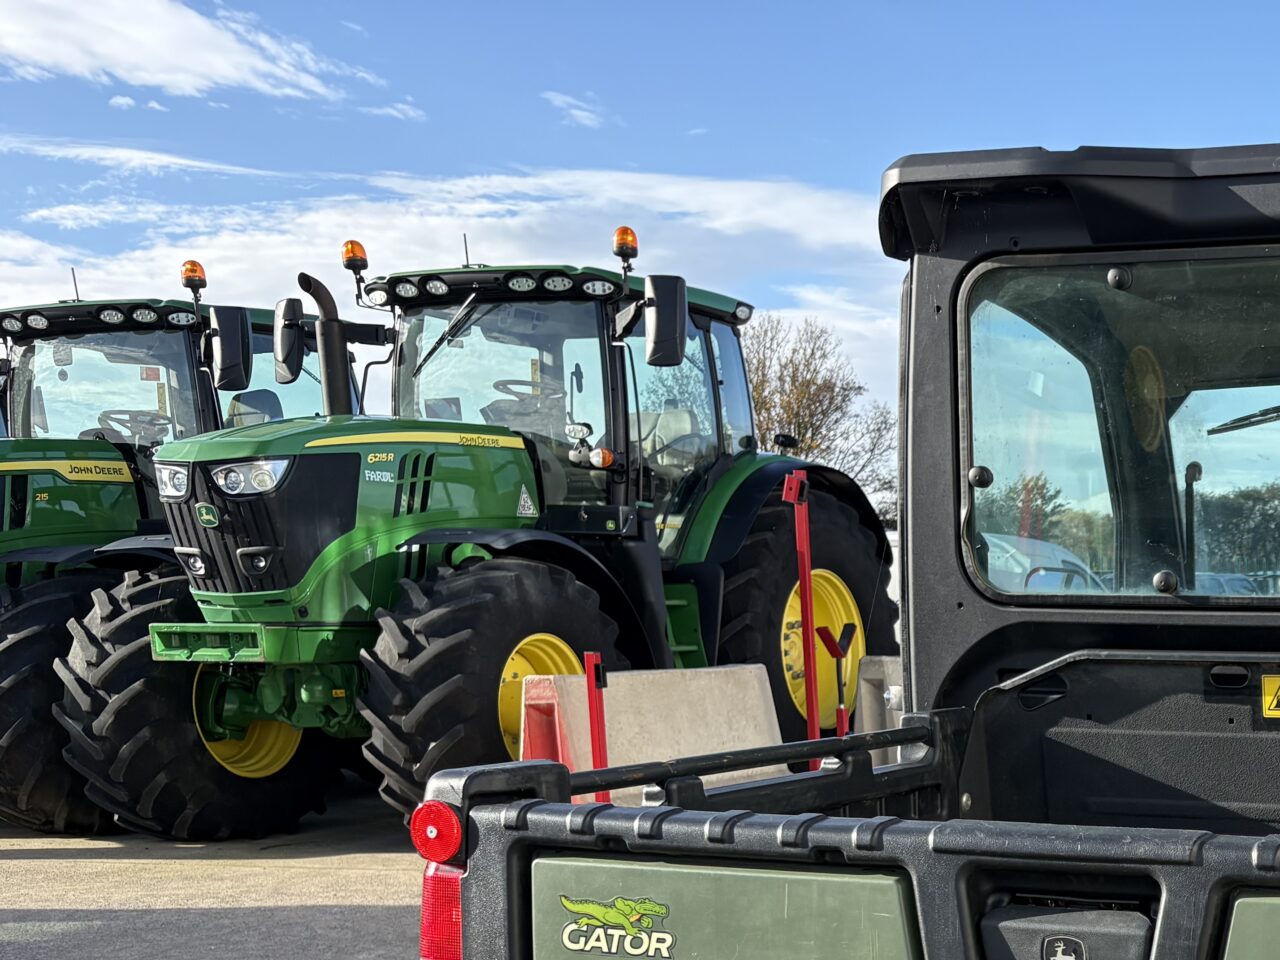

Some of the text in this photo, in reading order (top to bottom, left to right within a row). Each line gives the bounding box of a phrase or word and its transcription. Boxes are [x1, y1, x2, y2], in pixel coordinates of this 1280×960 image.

[69, 464, 124, 475] JOHN DEERE
[36, 493, 48, 501] 215
[562, 921, 673, 958] GATOR
